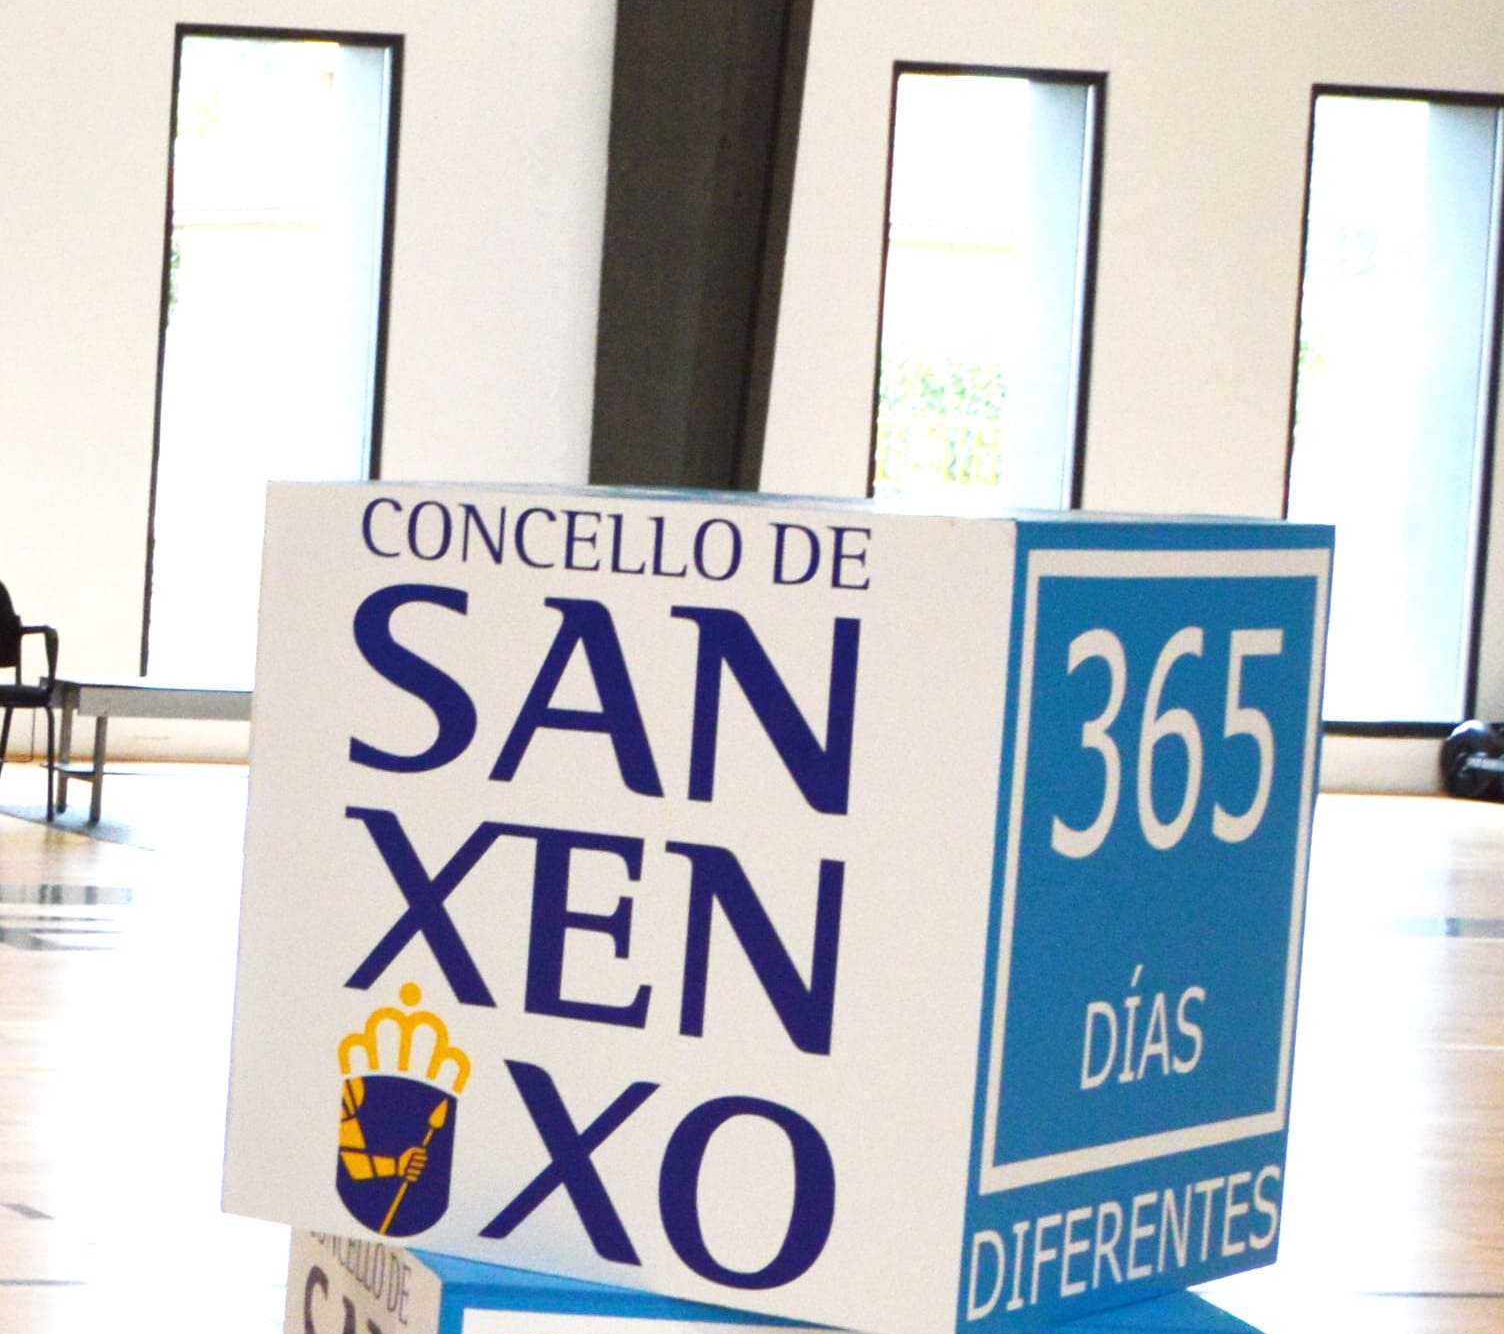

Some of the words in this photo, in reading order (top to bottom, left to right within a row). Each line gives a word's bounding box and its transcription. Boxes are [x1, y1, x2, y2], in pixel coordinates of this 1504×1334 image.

[361, 496, 743, 582] CONCELLO
[770, 521, 872, 592] DE
[348, 582, 862, 817] SAN
[1049, 625, 1285, 860] 365
[342, 804, 846, 1057] XEN
[1079, 964, 1207, 1091] DÍAS
[476, 1058, 837, 1292] XO
[965, 1164, 1282, 1323] DIFERENTES
[387, 1252, 412, 1326] DE
